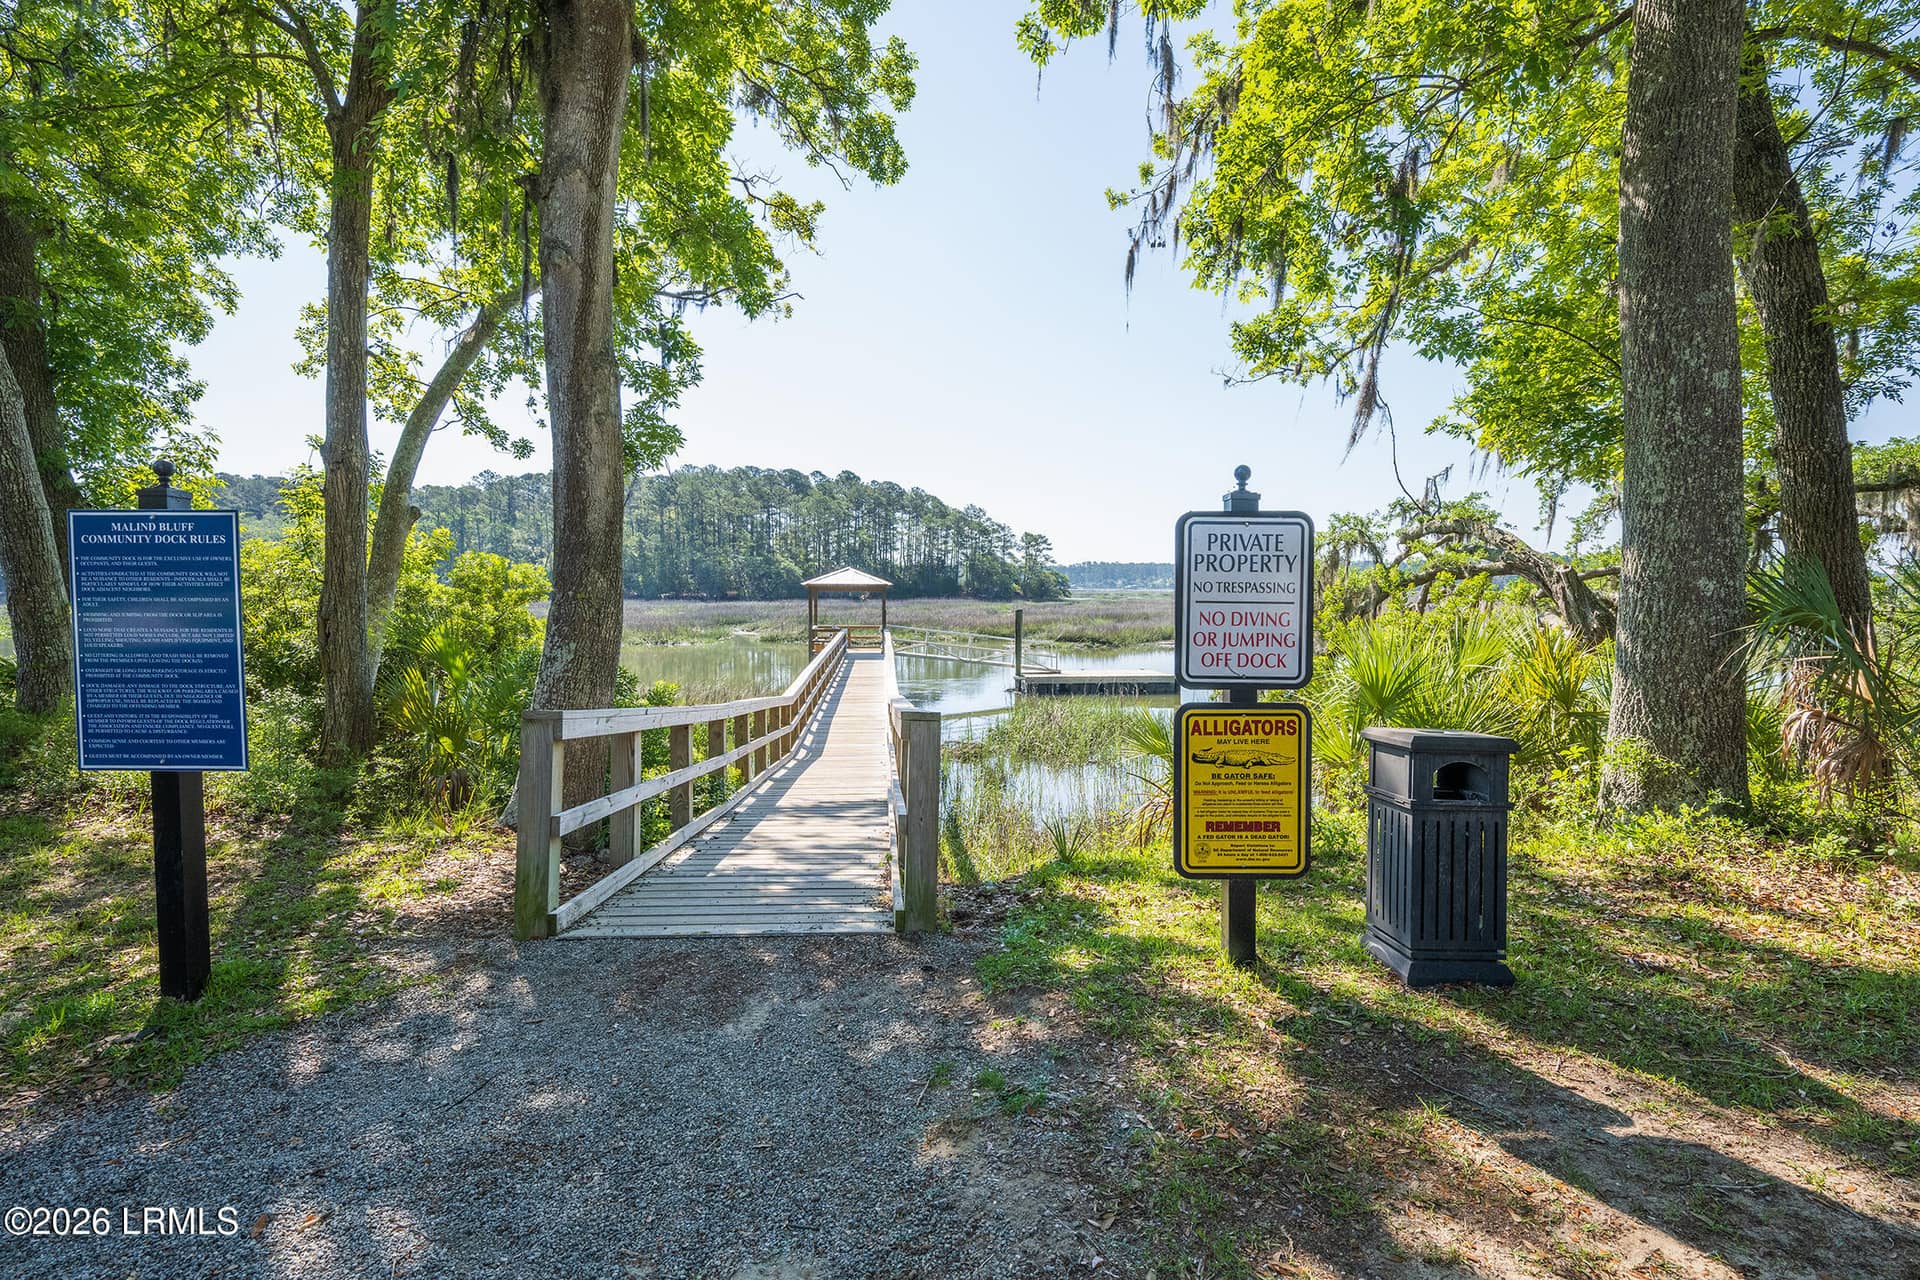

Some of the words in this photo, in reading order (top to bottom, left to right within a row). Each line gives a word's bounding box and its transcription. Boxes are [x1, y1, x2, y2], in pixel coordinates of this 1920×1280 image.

[112, 522, 156, 532] MALIND
[160, 522, 194, 532] BLUFF
[81, 534, 150, 544] COMMUNITY
[154, 534, 186, 544] DOCK
[190, 535, 226, 544] RULES
[1208, 534, 1284, 552] PRIVATE
[1194, 554, 1298, 572] PROPERTY
[1194, 582, 1213, 592] NO
[1216, 582, 1296, 594] TRESPASSING
[1200, 612, 1226, 626] NO
[1231, 612, 1290, 627] DIVING
[1193, 632, 1217, 646] OR
[1222, 632, 1296, 650] JUMPING
[1201, 652, 1232, 667] OFF
[1237, 653, 1287, 668] DOCK
[1191, 720, 1297, 736] ALLIGATORS
[1206, 821, 1280, 832] REMEMBER
